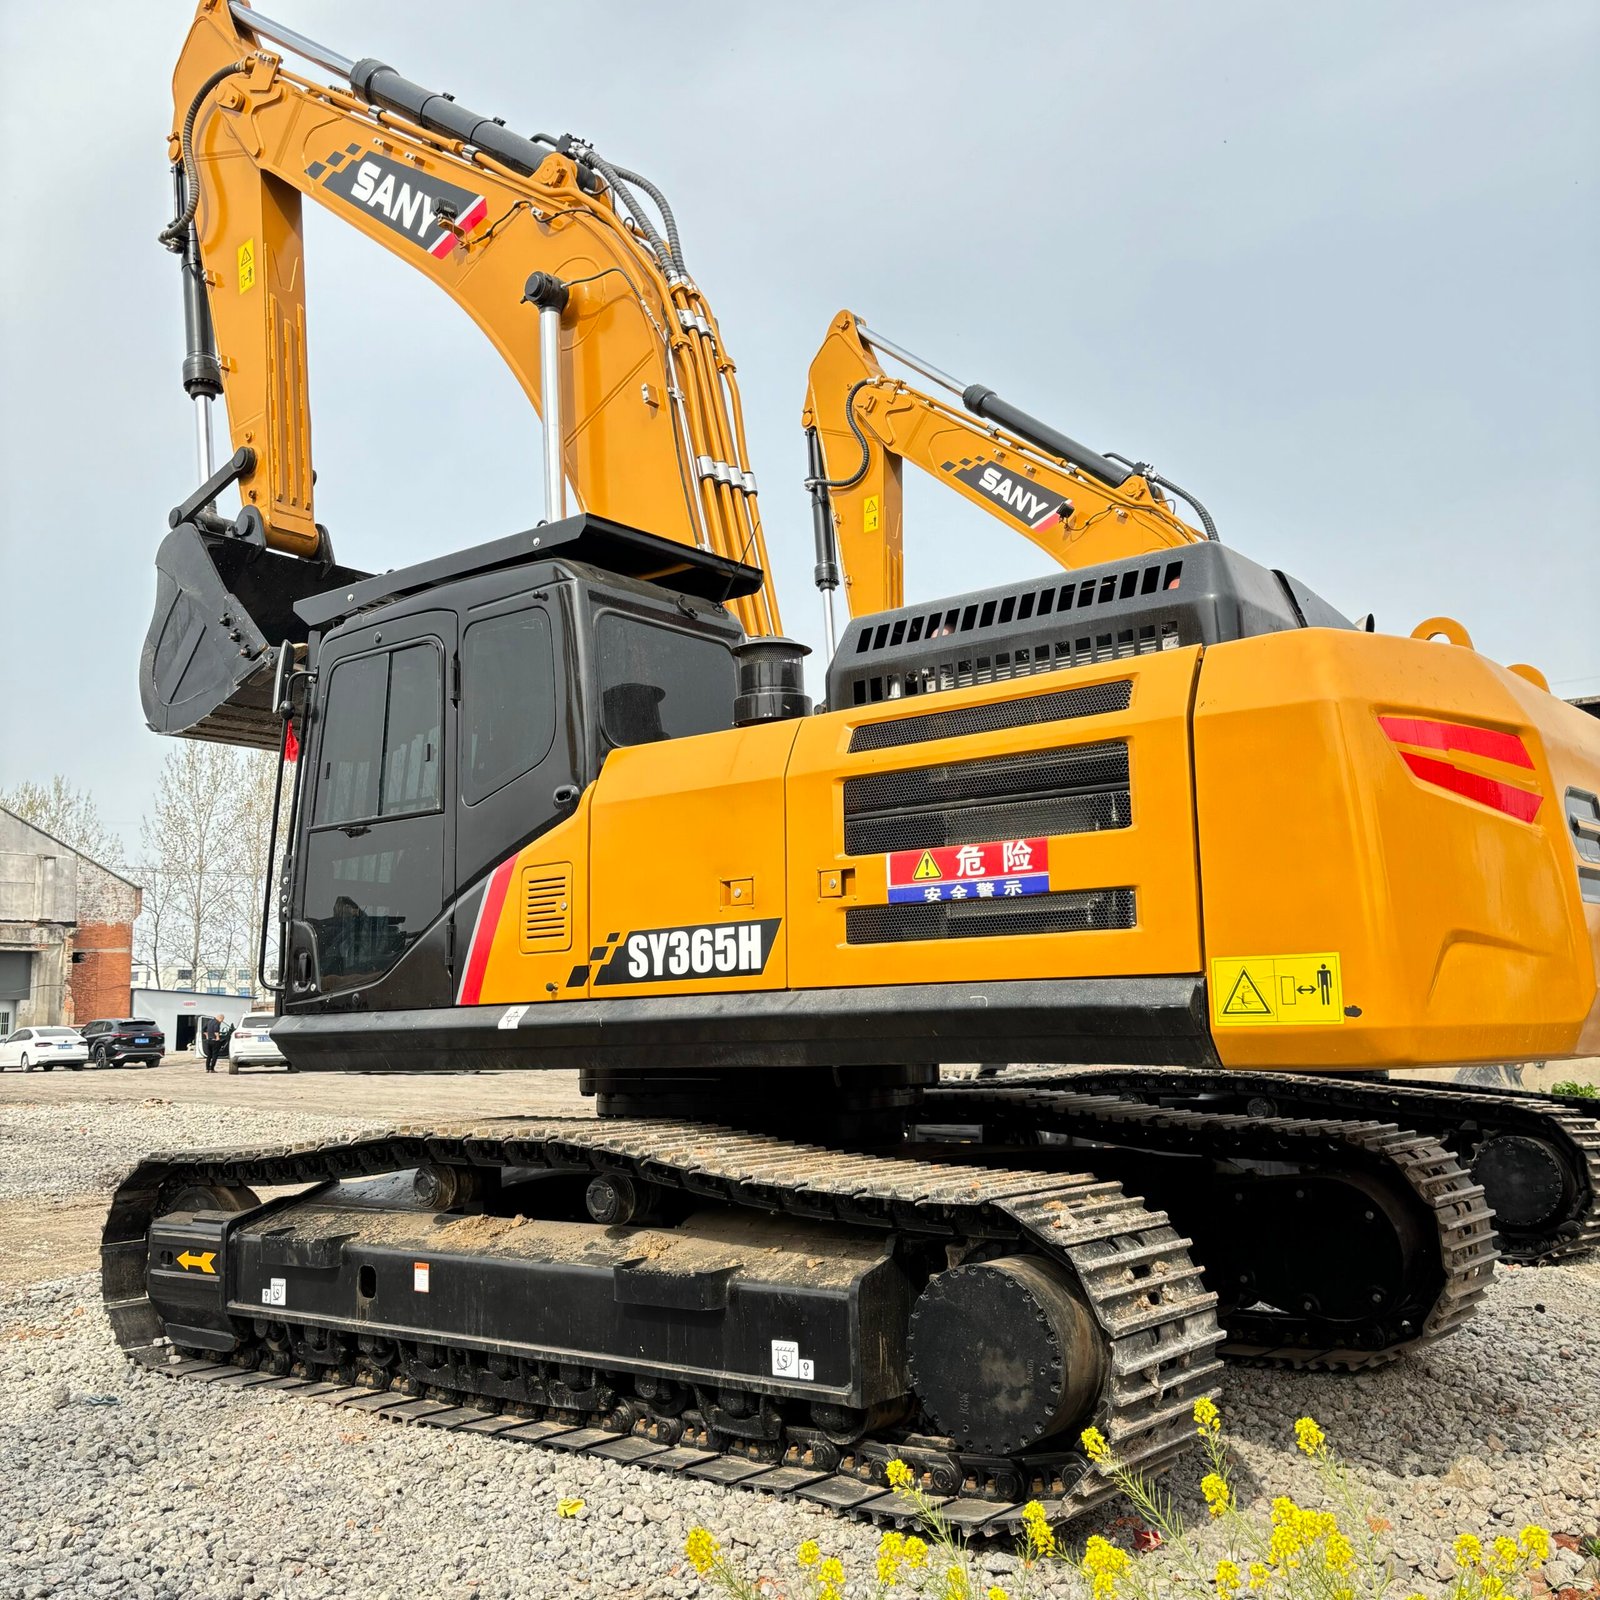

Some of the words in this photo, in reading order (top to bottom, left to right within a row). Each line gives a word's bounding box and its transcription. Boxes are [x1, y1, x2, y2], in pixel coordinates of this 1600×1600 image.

[350, 160, 438, 238] SANY
[978, 467, 1049, 519] SANY
[955, 840, 1033, 877] 危险
[924, 880, 1023, 903] 安全警示
[627, 924, 762, 978] SY365H
